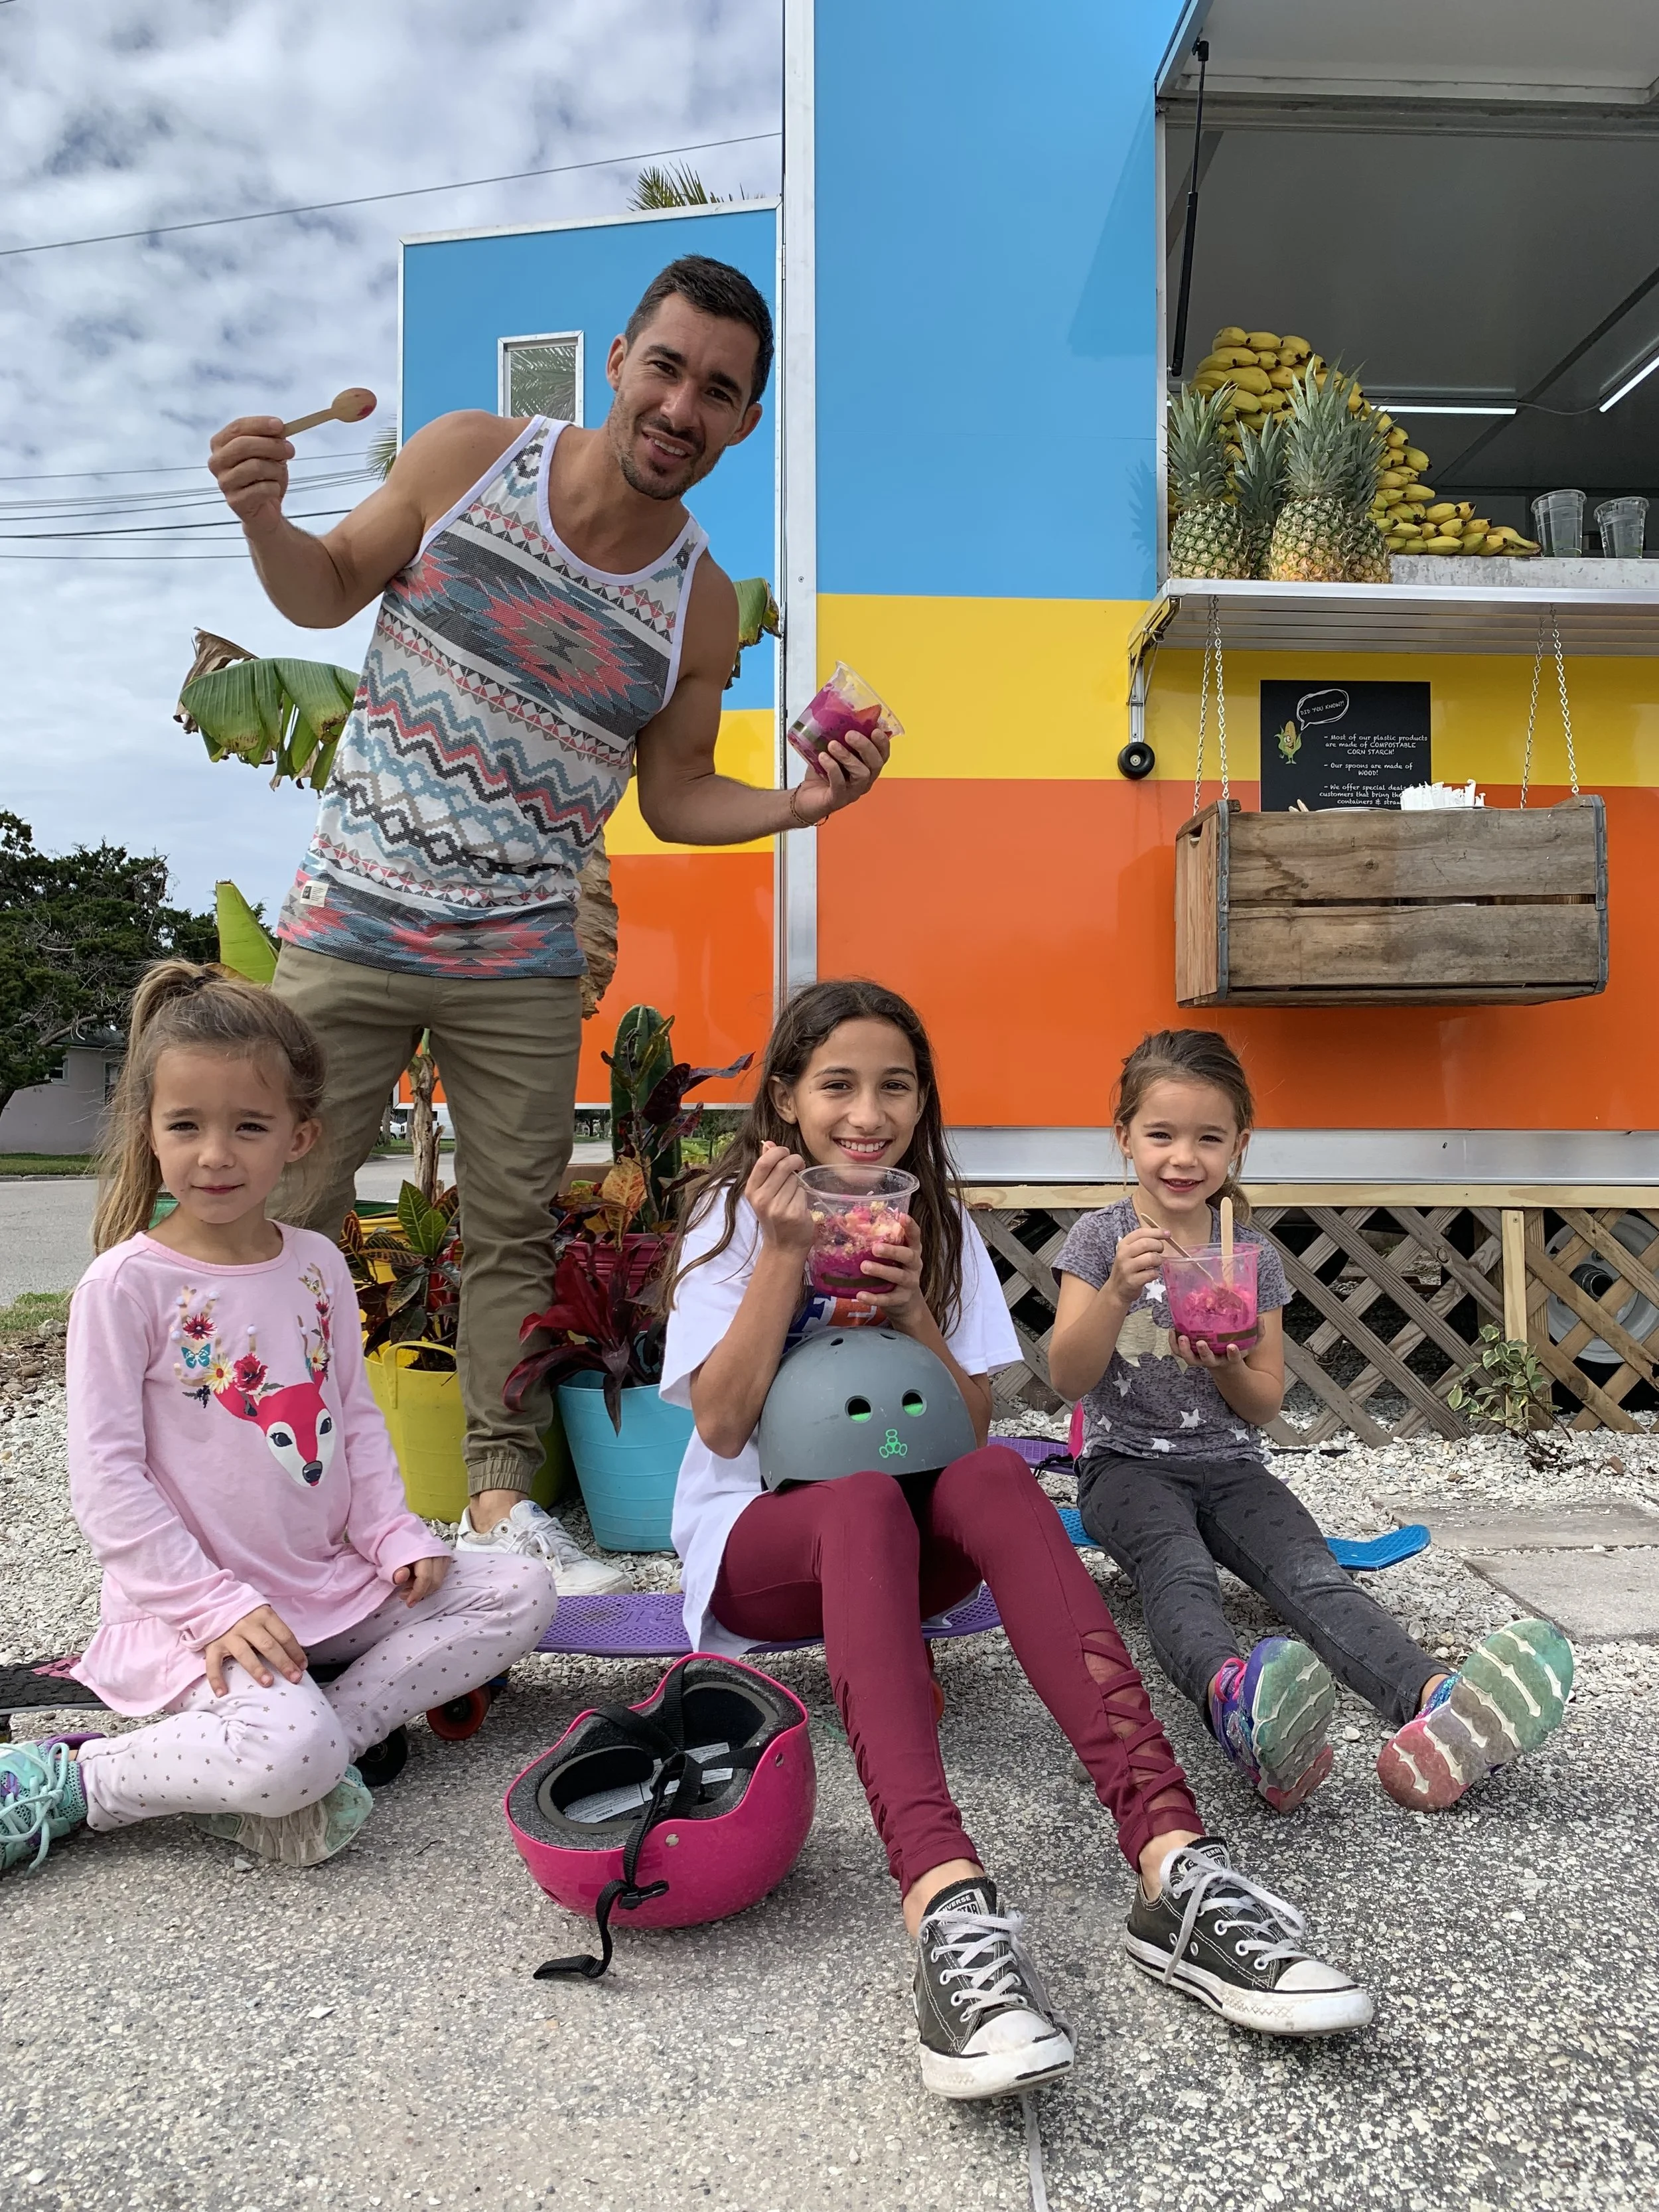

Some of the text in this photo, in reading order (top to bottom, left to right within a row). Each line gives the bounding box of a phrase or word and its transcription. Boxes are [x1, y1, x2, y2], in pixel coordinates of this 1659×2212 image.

[1325, 700, 1344, 709] KNOW?!
[1374, 733, 1396, 743] plastic
[1399, 734, 1428, 743] products
[1342, 782, 1360, 791] offer
[1362, 784, 1386, 792] special
[1372, 790, 1390, 799] bring
